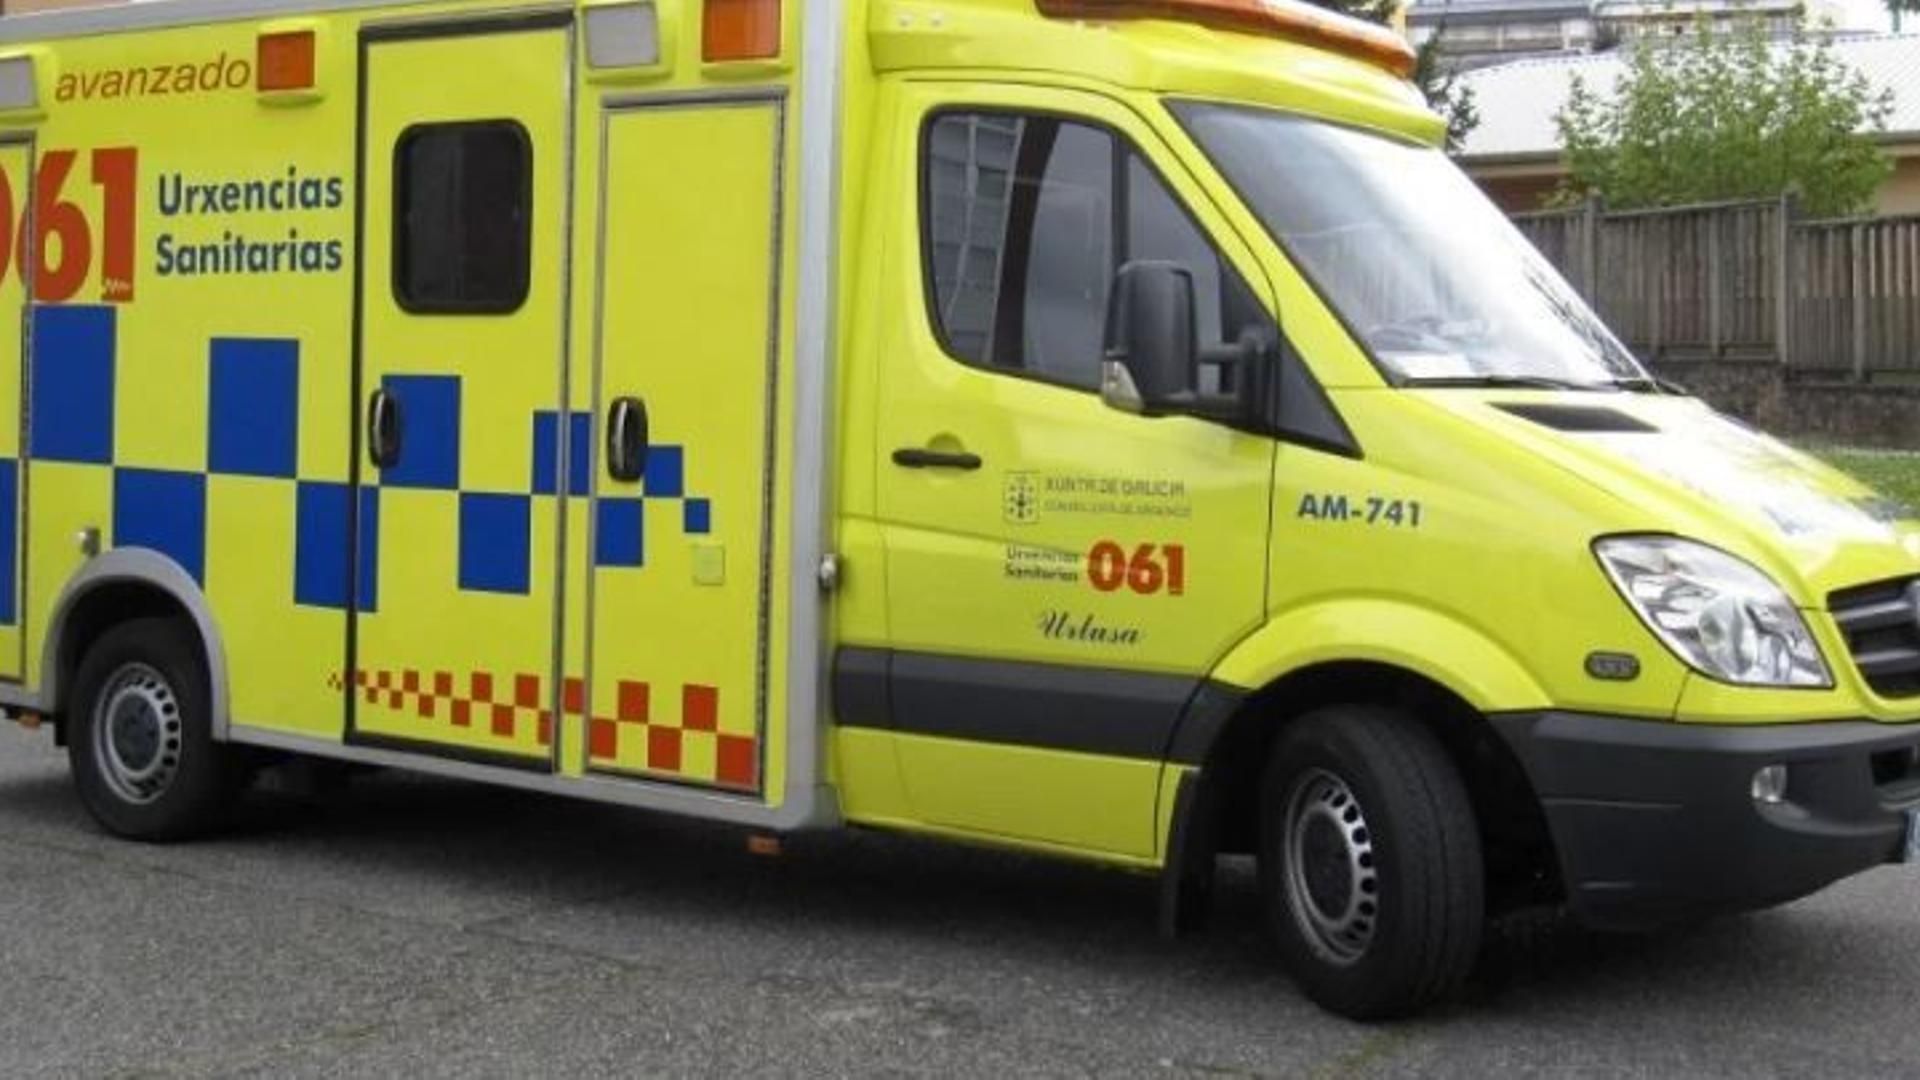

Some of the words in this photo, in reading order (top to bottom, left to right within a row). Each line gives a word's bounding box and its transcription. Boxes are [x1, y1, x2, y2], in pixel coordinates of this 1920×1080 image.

[55, 52, 251, 102] avanzado
[158, 167, 343, 216] Urxencias
[0, 146, 138, 304] 61
[155, 231, 343, 276] Sanitarias
[1298, 493, 1421, 527] AM-741
[1087, 540, 1185, 596] 061
